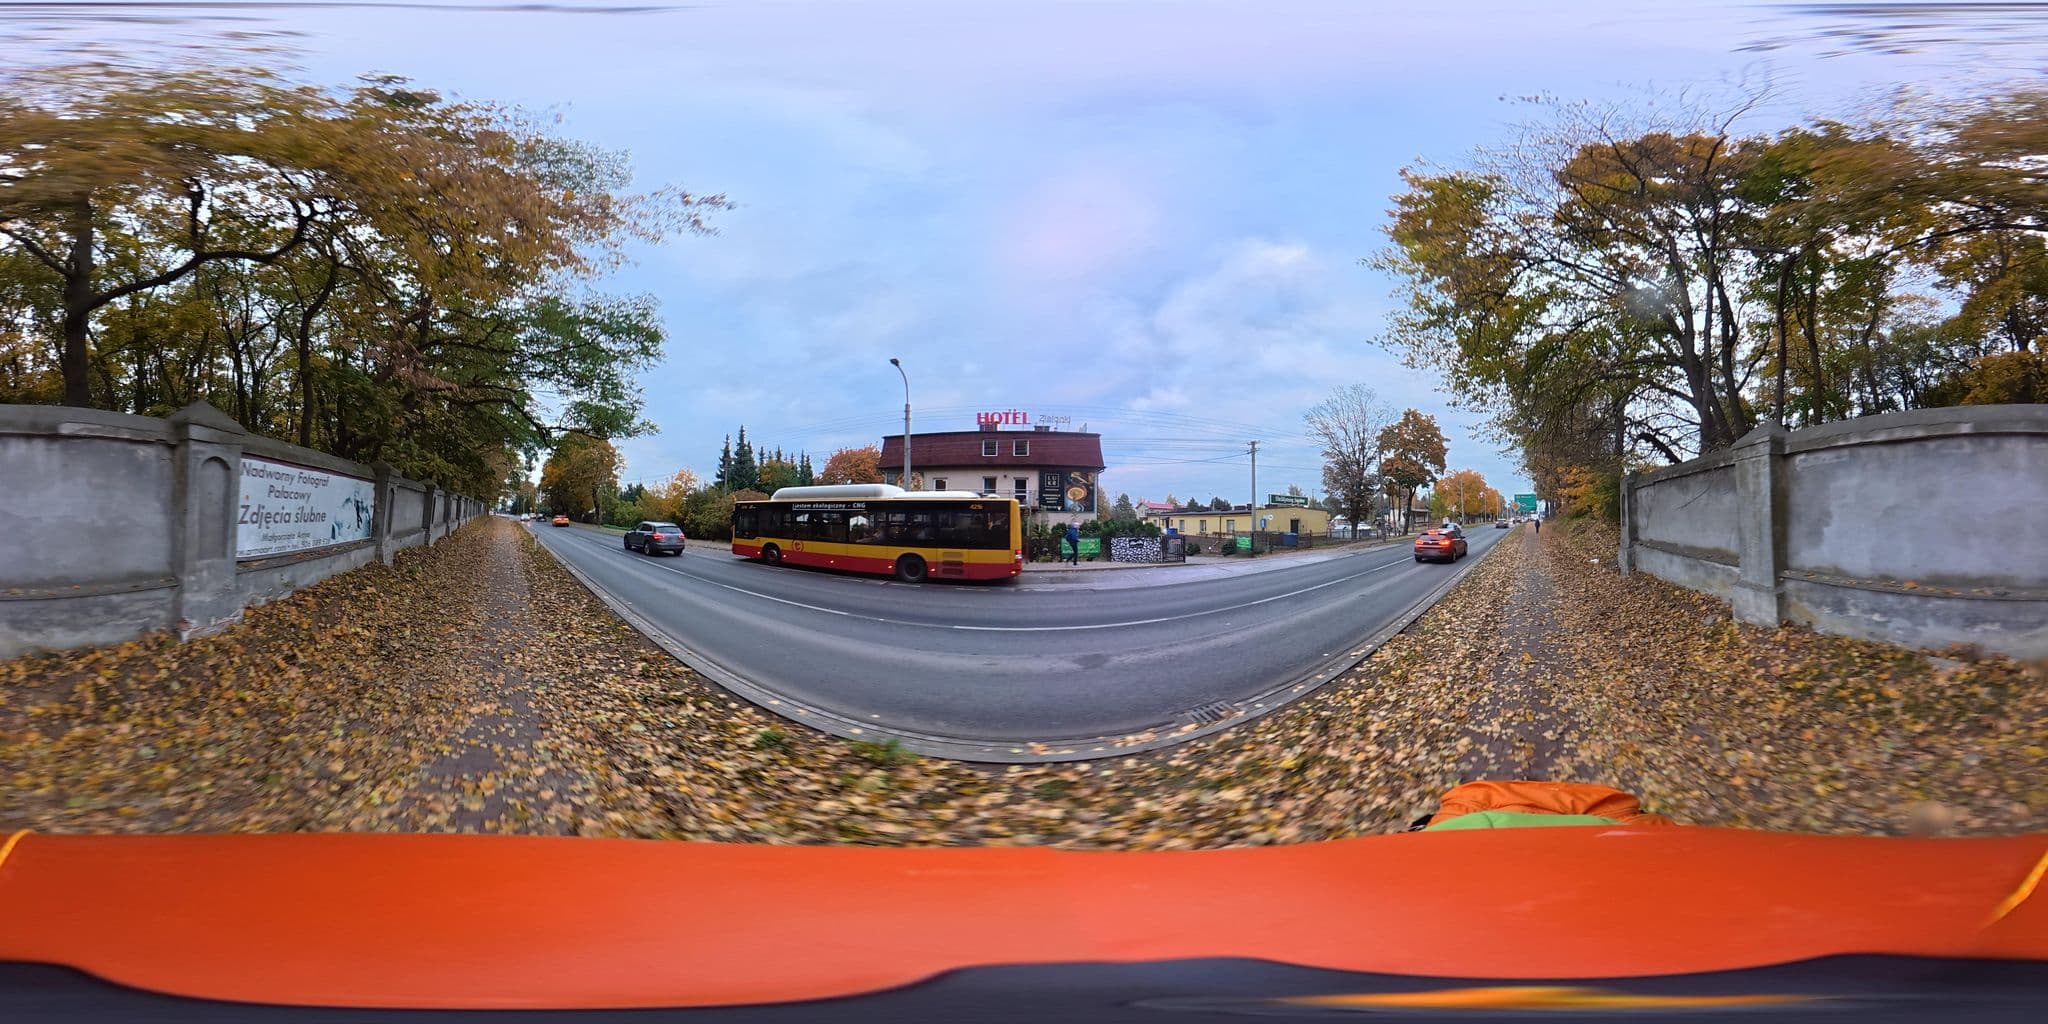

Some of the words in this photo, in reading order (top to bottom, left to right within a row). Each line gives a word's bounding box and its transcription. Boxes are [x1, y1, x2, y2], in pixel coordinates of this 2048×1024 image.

[977, 411, 1031, 425] HOTEL
[240, 461, 296, 486] Nadworny
[297, 471, 330, 489] Fotograf
[267, 484, 312, 503] Pałacowy
[238, 504, 292, 529] Zdjęcia
[294, 506, 327, 523] ślubne
